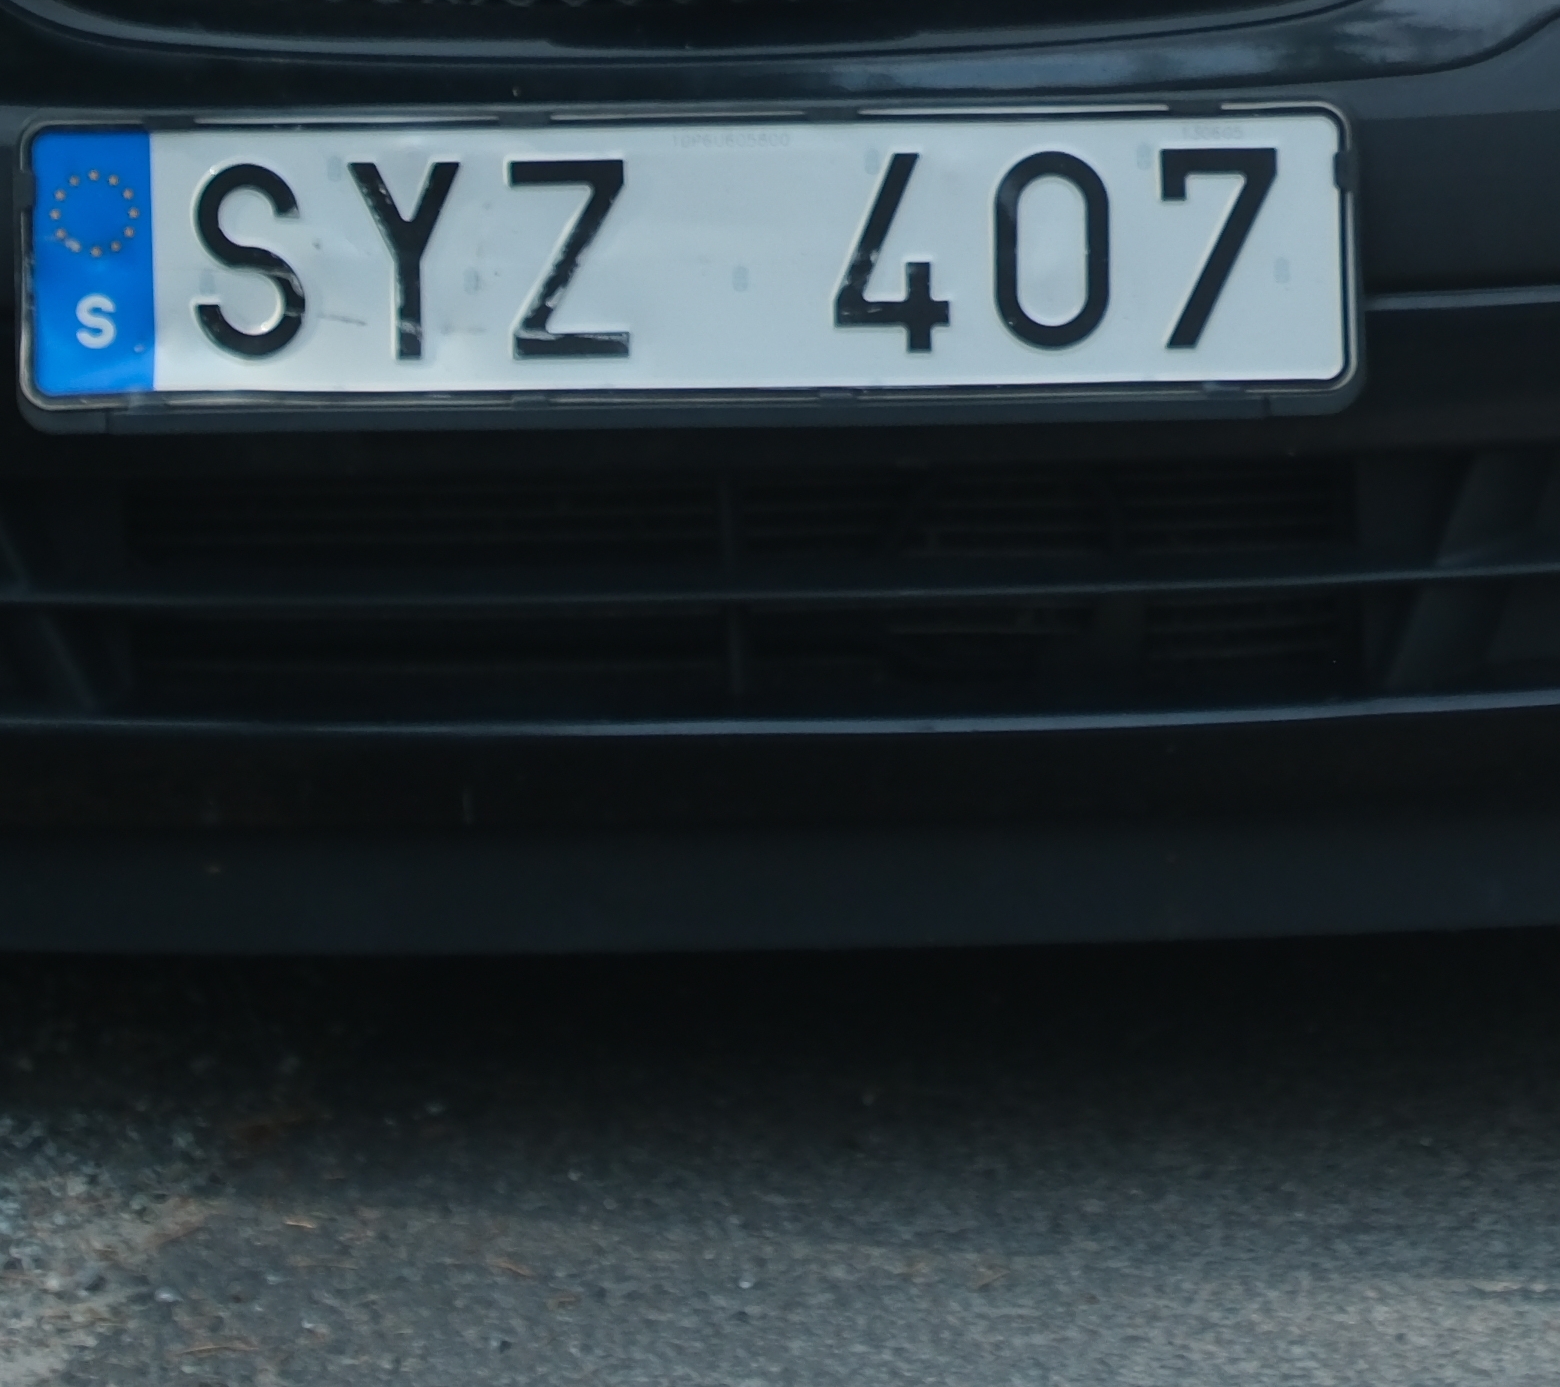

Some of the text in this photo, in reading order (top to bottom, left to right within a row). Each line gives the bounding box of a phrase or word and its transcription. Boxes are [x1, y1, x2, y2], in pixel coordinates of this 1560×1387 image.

[194, 147, 1279, 360] SYZ 407
[76, 293, 117, 349] S
